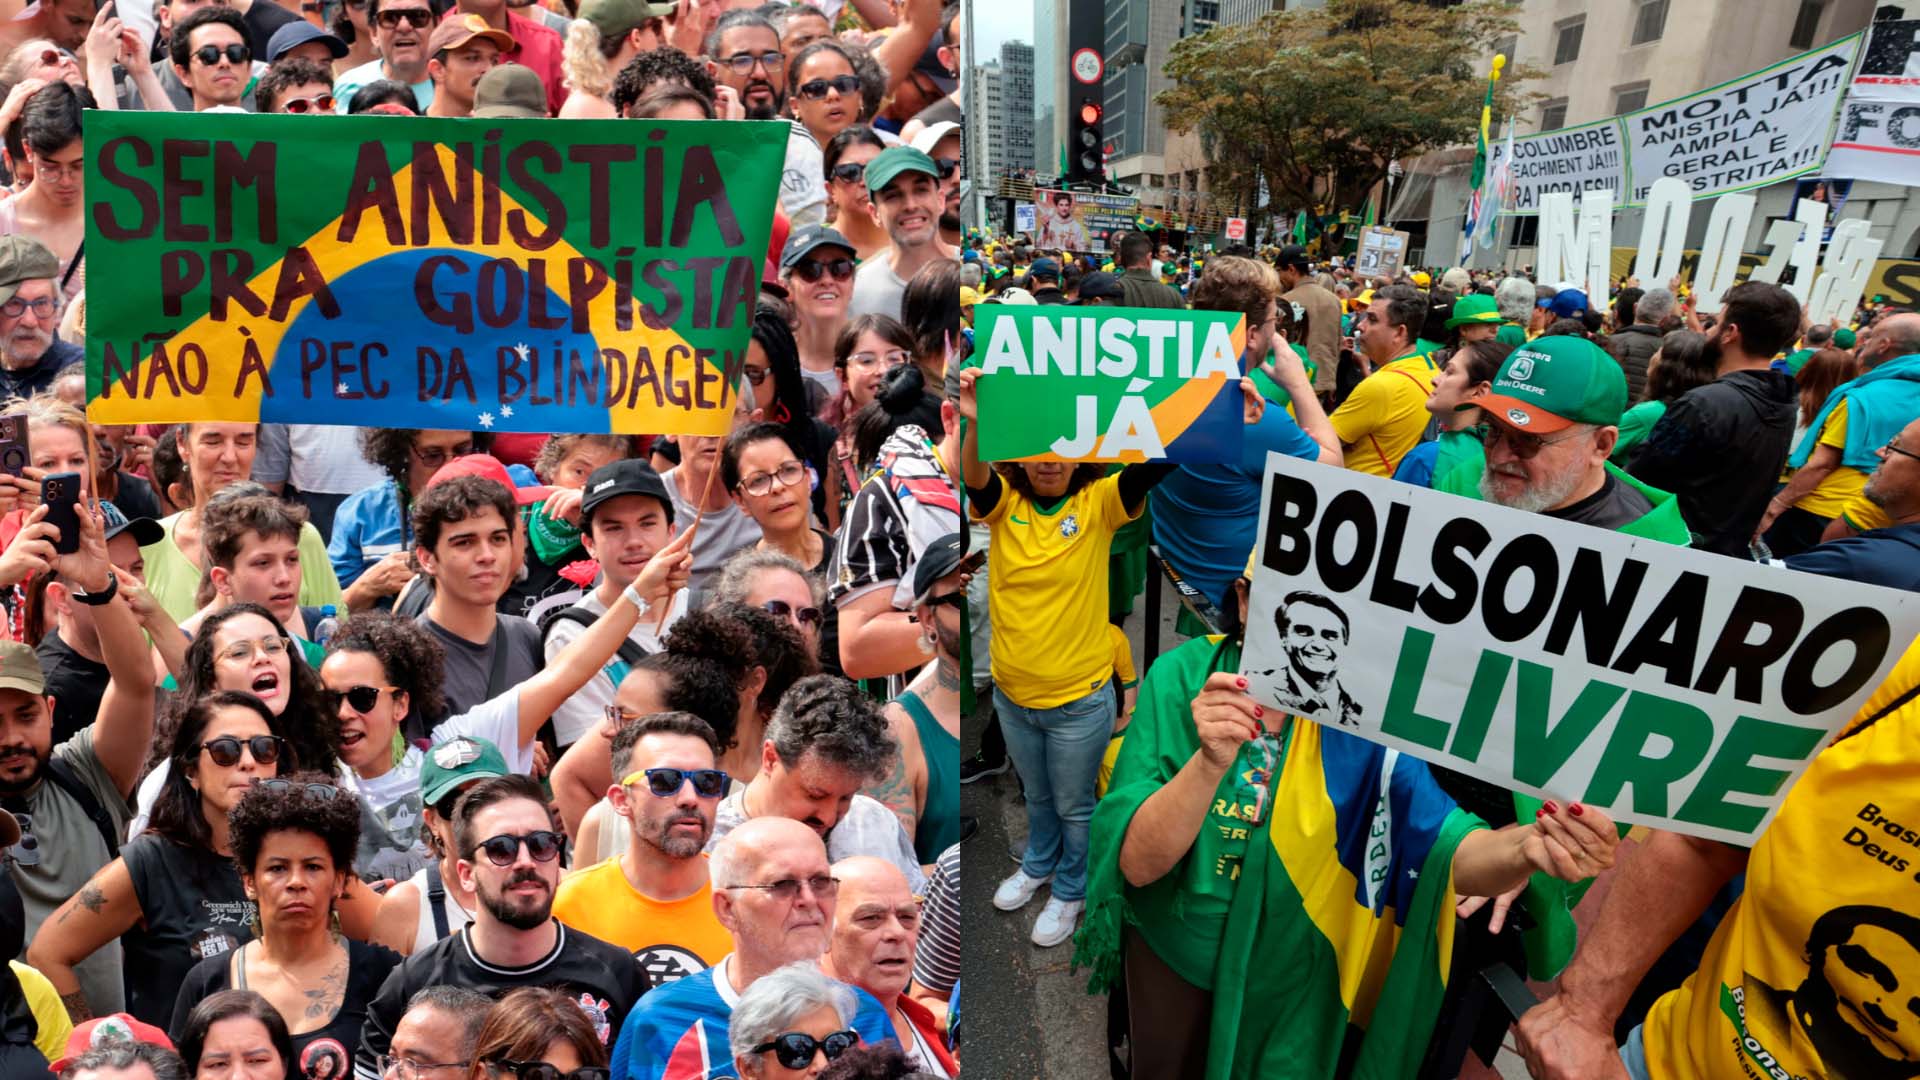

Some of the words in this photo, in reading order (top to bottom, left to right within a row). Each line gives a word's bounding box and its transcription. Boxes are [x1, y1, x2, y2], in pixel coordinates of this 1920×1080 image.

[1642, 55, 1848, 132] MOTTA
[1642, 108, 1750, 148] ANISTIA
[1663, 146, 1758, 177] GERAL
[1770, 134, 1788, 153] E
[1669, 119, 1778, 158] AMPLA,
[94, 136, 277, 243] SEM
[161, 247, 341, 322] PRA
[101, 330, 208, 399] NÃO
[234, 327, 274, 398] À
[301, 338, 389, 400] PEC
[417, 346, 476, 405] DA
[981, 315, 1241, 379] ANISTIA
[1049, 377, 1167, 459] JÁ
[1262, 472, 1890, 716] BOLSONARO
[1380, 626, 1827, 836] LIVRE
[1843, 826, 1910, 873] Deus
